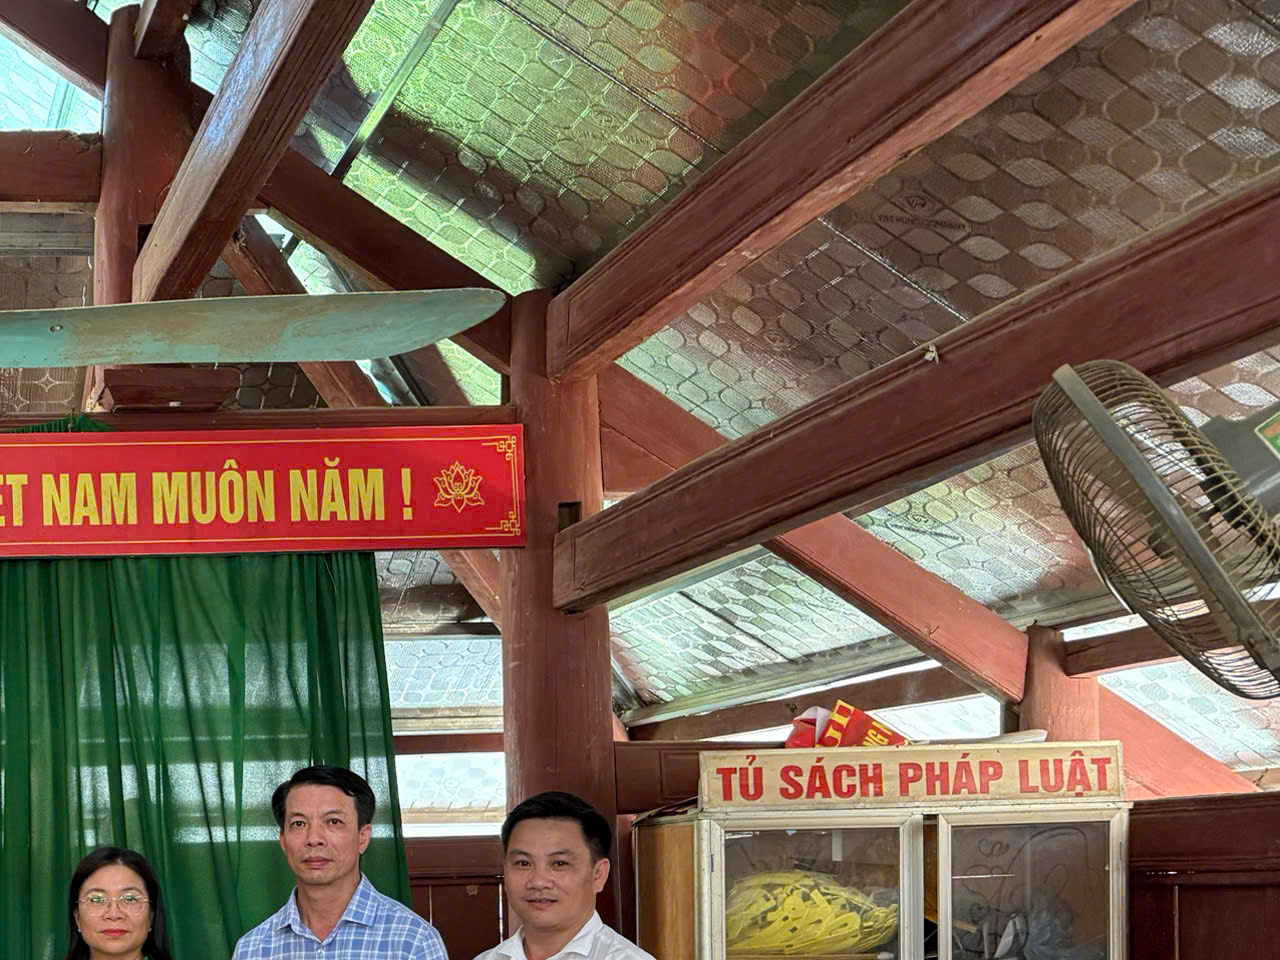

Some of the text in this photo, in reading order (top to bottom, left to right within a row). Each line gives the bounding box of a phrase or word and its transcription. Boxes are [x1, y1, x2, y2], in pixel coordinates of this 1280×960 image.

[42, 472, 138, 526] NAM
[152, 459, 276, 525] MUÔN
[290, 457, 385, 522] NĂM
[401, 468, 413, 521] !
[715, 750, 1111, 801] TỦ SÁCH PHÁP LUẬT
